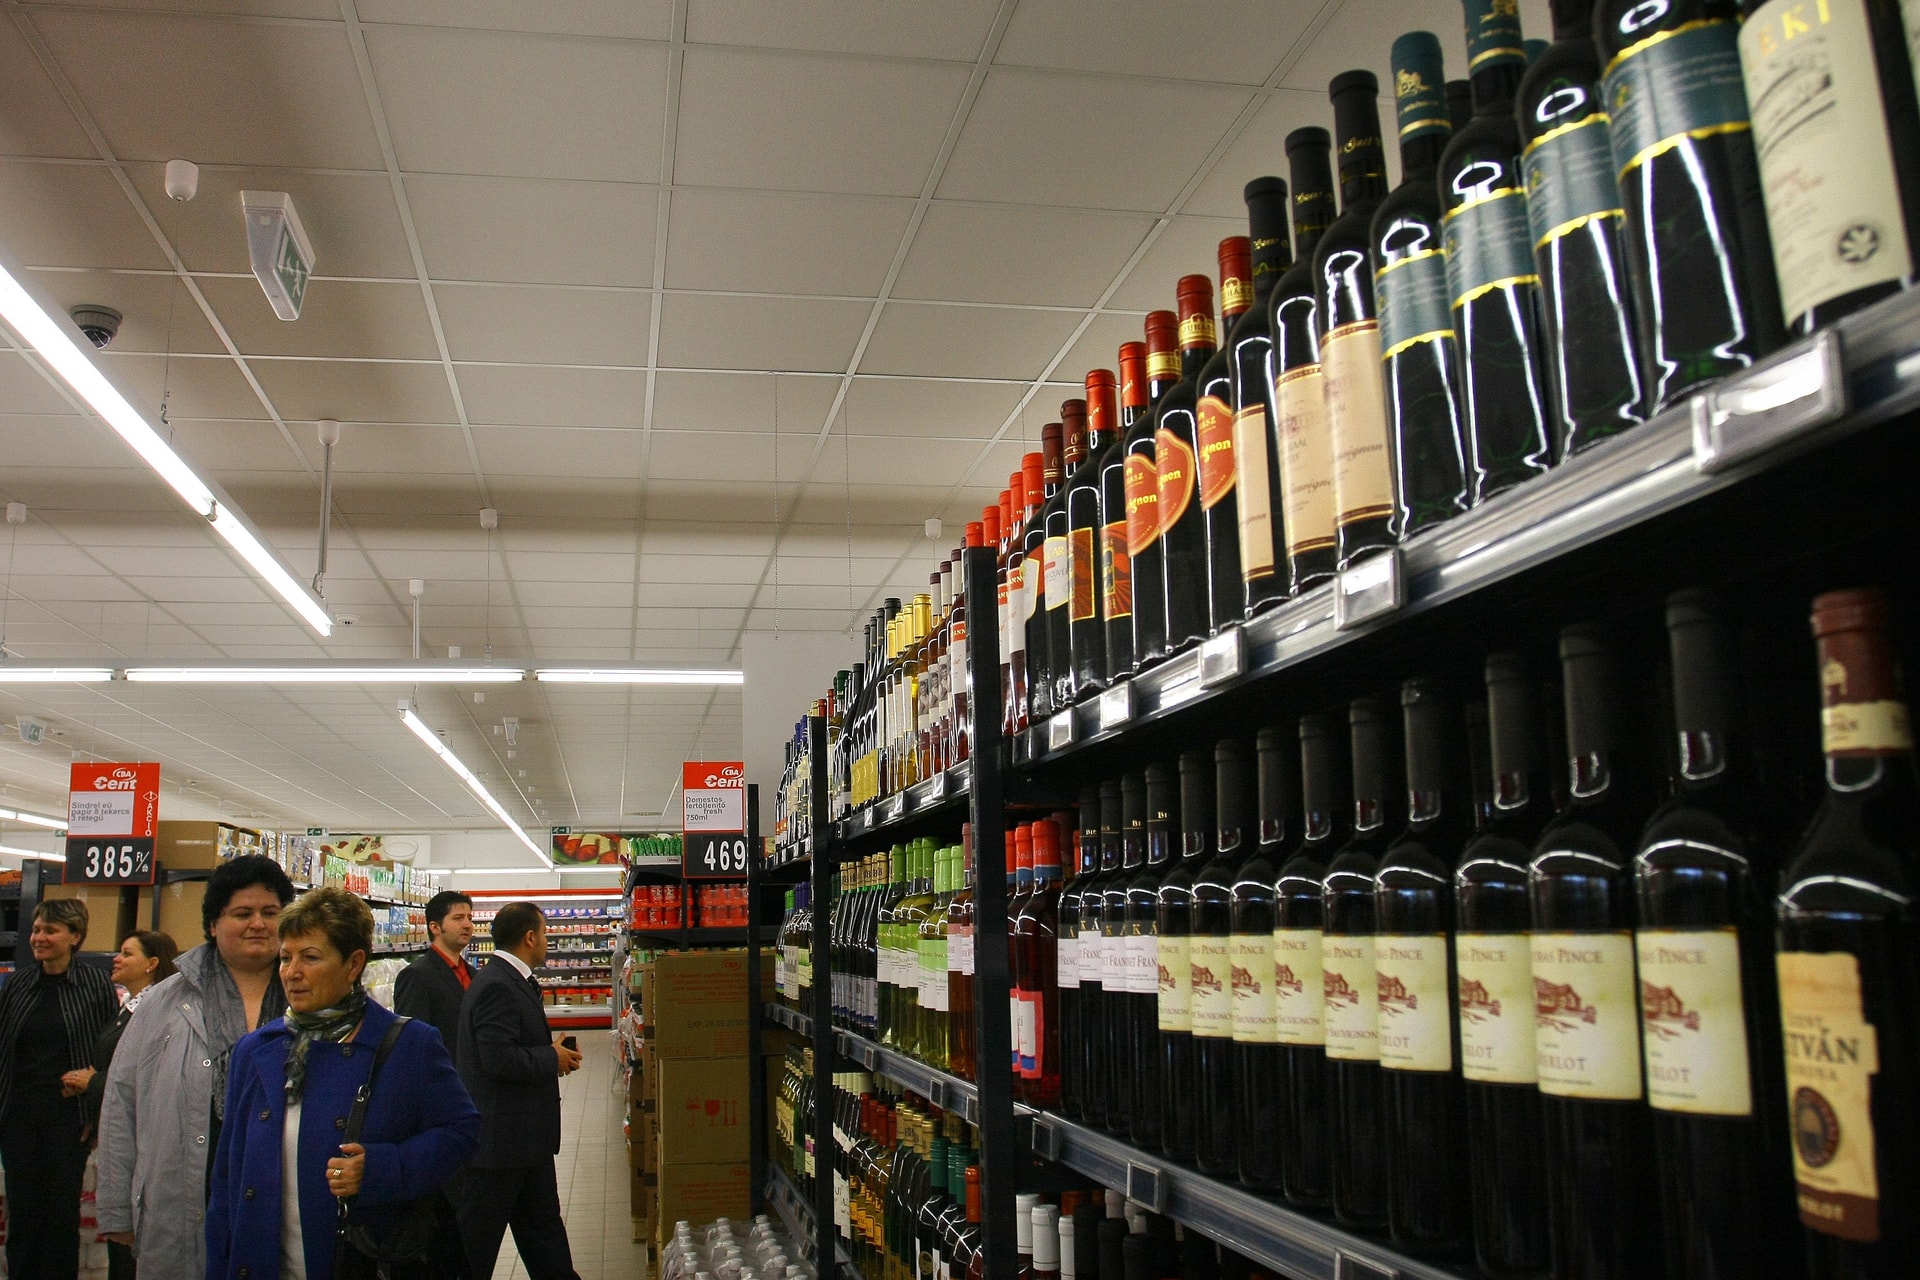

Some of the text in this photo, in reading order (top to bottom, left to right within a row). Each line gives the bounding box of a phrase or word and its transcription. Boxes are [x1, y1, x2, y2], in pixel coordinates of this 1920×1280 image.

[93, 776, 137, 790] Cent
[86, 846, 133, 878] 385
[704, 840, 746, 871] 469
[1558, 949, 1603, 964] PINCE
